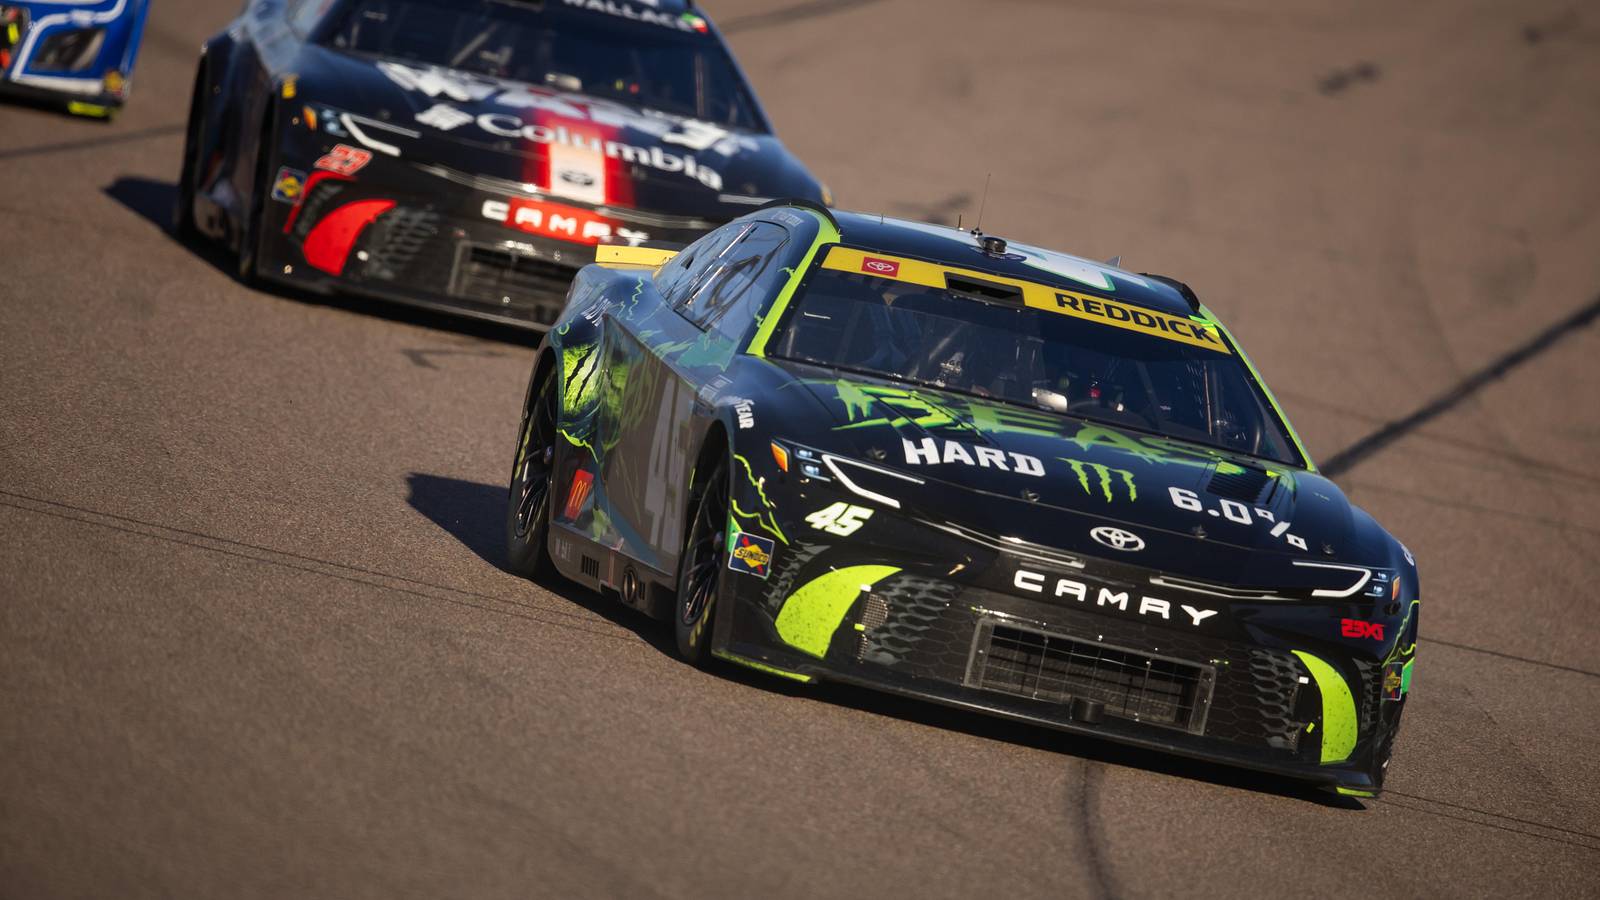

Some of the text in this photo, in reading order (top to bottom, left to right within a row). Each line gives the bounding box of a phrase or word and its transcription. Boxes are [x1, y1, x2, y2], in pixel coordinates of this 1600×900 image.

[477, 113, 723, 190] Columbia
[481, 199, 650, 247] CAMRY
[1055, 292, 1220, 345] REDDICK
[901, 437, 1047, 477] HARD
[805, 501, 875, 537] 45
[1167, 486, 1309, 552] 6.0%
[735, 548, 770, 565] SUNOCO
[1013, 569, 1219, 627] CAMRY
